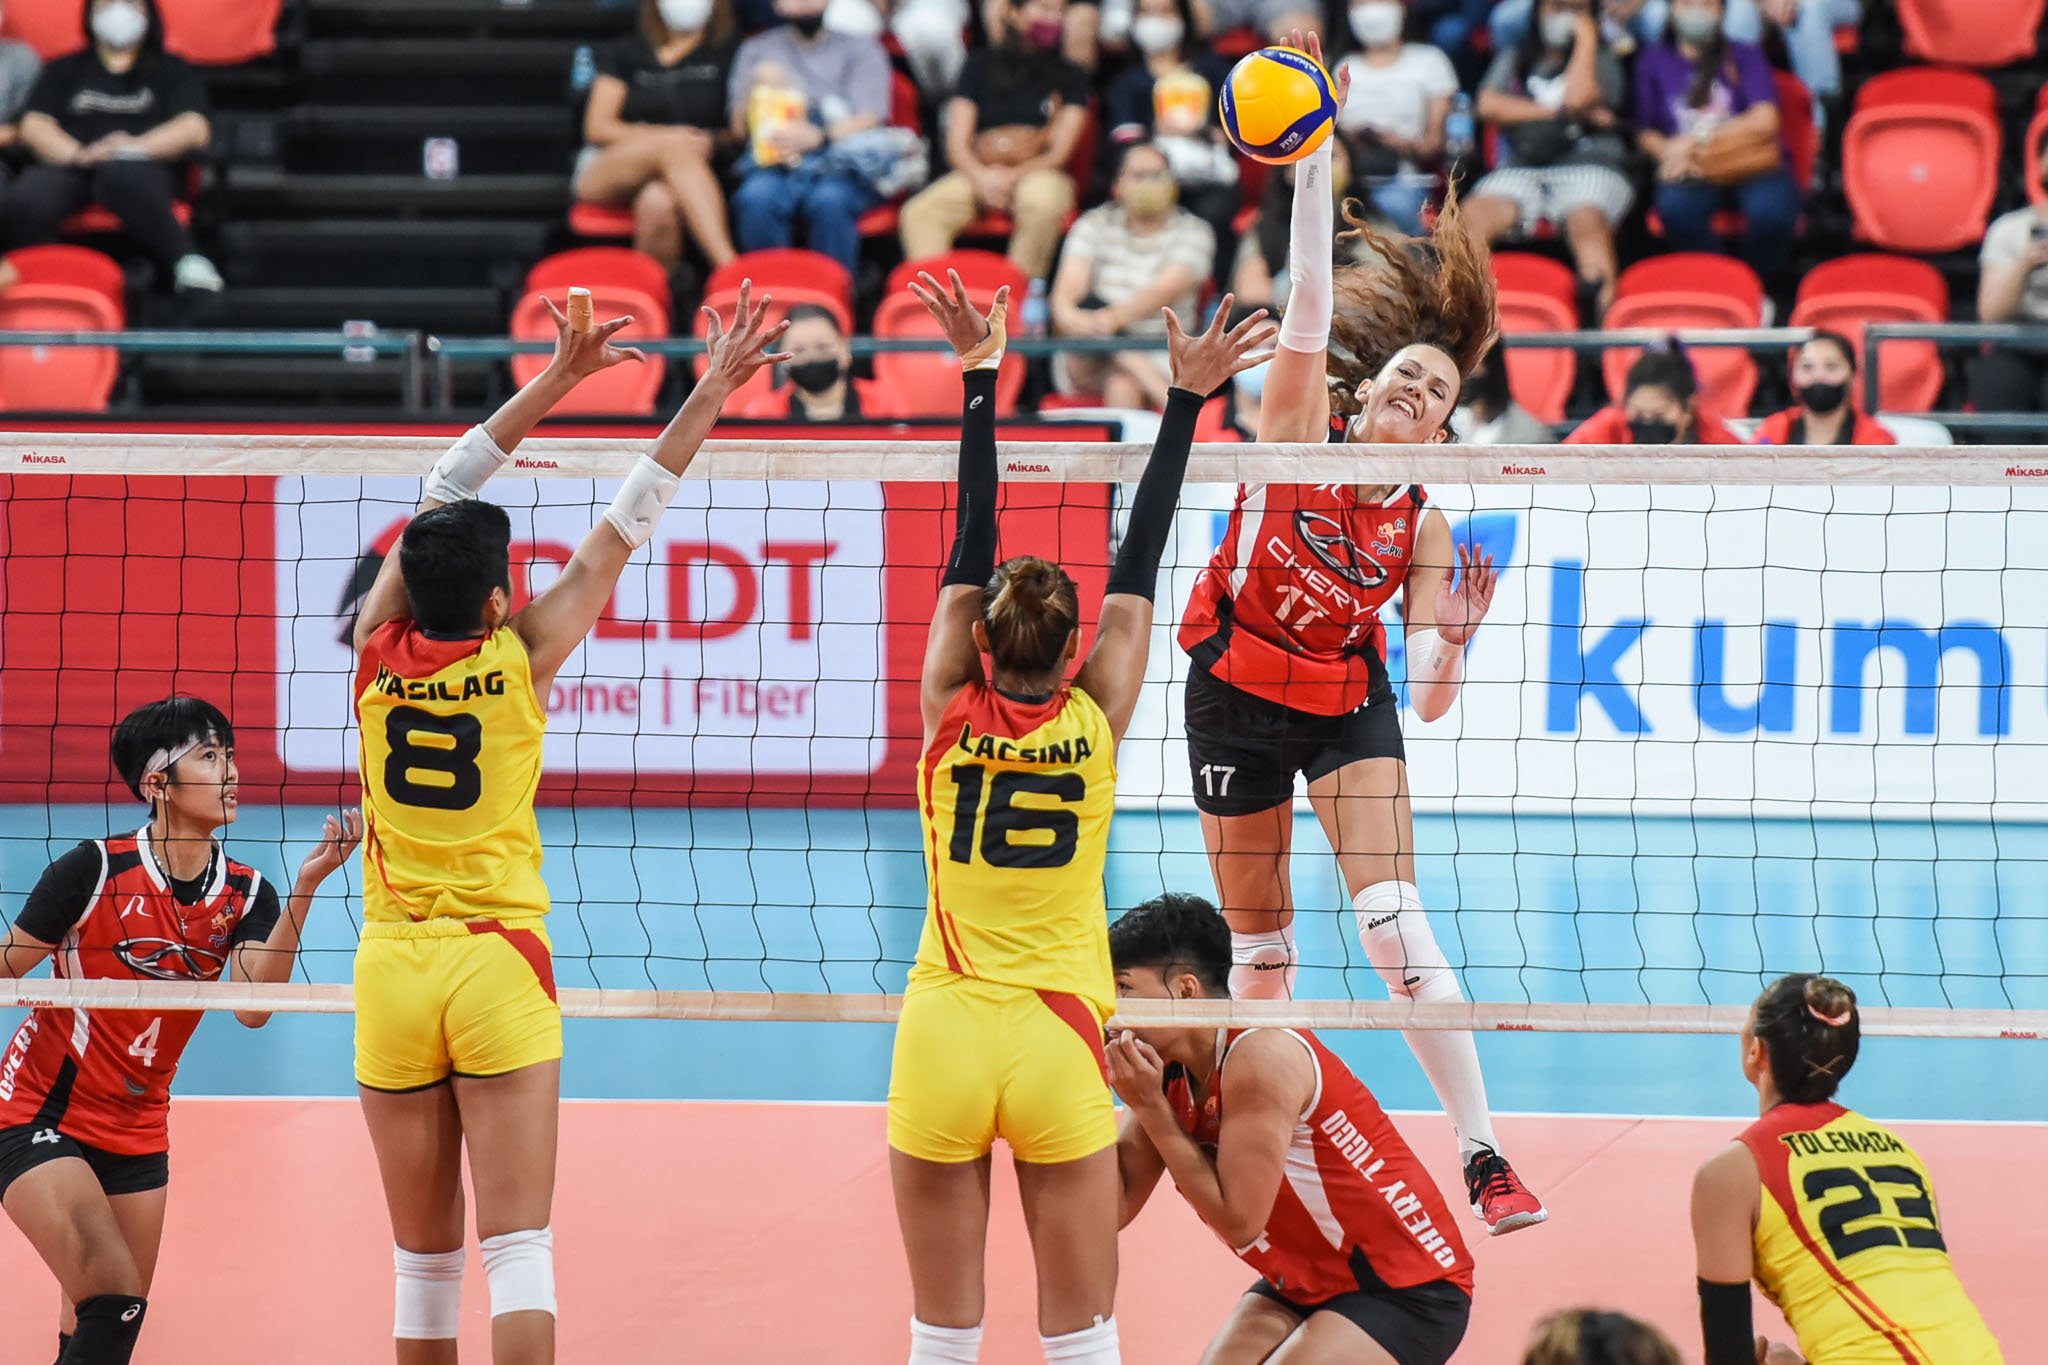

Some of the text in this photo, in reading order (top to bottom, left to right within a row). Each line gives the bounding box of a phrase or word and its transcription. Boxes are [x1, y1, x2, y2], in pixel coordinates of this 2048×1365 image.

[1266, 535, 1374, 617] CHERY
[375, 662, 504, 702] HASILAG
[692, 676, 812, 717] Fiber
[384, 704, 483, 811] 8
[958, 722, 1092, 765] LACSINA
[1200, 763, 1236, 797] 17
[949, 763, 1086, 868] 16
[128, 1017, 162, 1067] 4
[32, 1128, 61, 1145] 4
[1780, 1130, 1905, 1157] TOLENADA
[1320, 1109, 1456, 1268] CHERY TIGGO
[1803, 1165, 1948, 1261] 23
